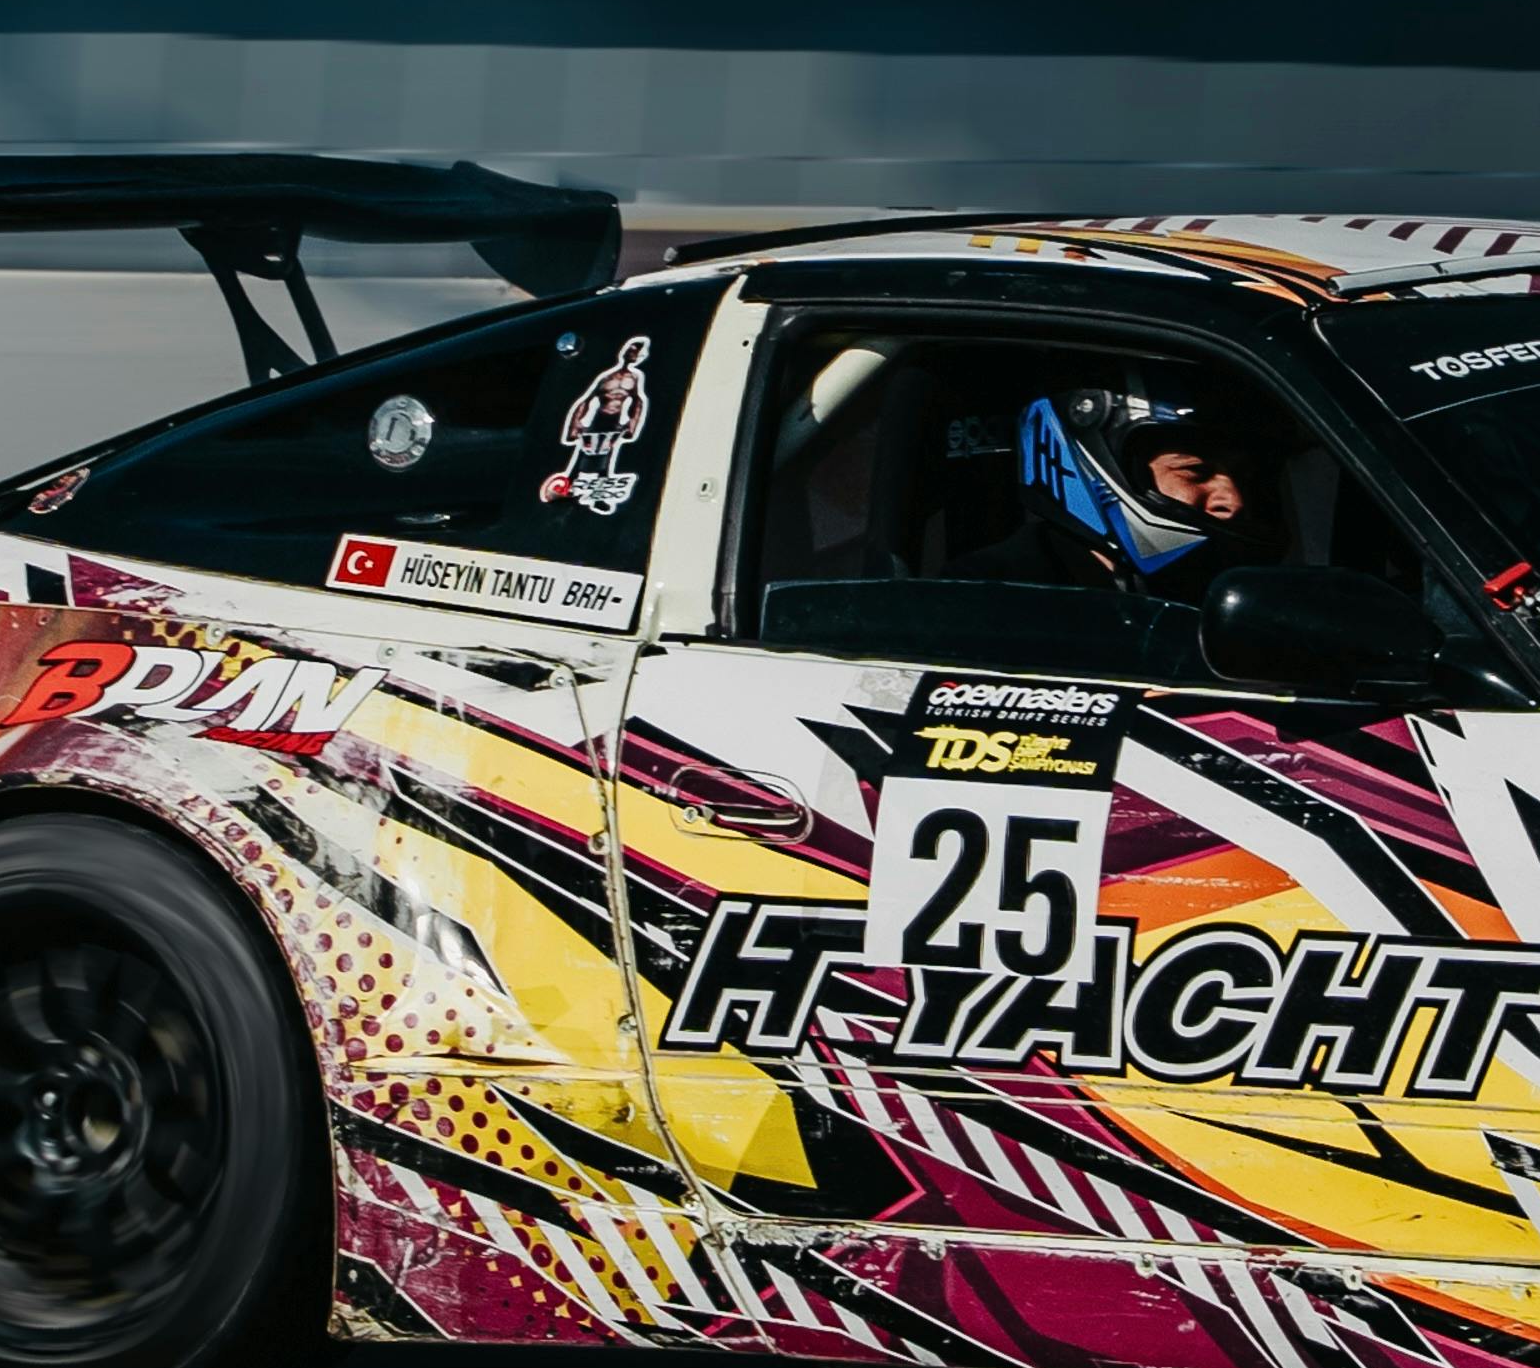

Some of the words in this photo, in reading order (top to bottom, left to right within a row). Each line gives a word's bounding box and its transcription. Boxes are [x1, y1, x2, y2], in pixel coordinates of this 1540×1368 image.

[401, 554, 486, 594] HÜSEYİN
[490, 569, 555, 603] TANTU
[562, 582, 622, 611] BRH-
[925, 705, 991, 718] TURKISH
[997, 710, 1046, 722] DRIFT
[1050, 714, 1108, 726] SERIES
[913, 724, 1018, 773] TDS
[901, 807, 1080, 977] 25
